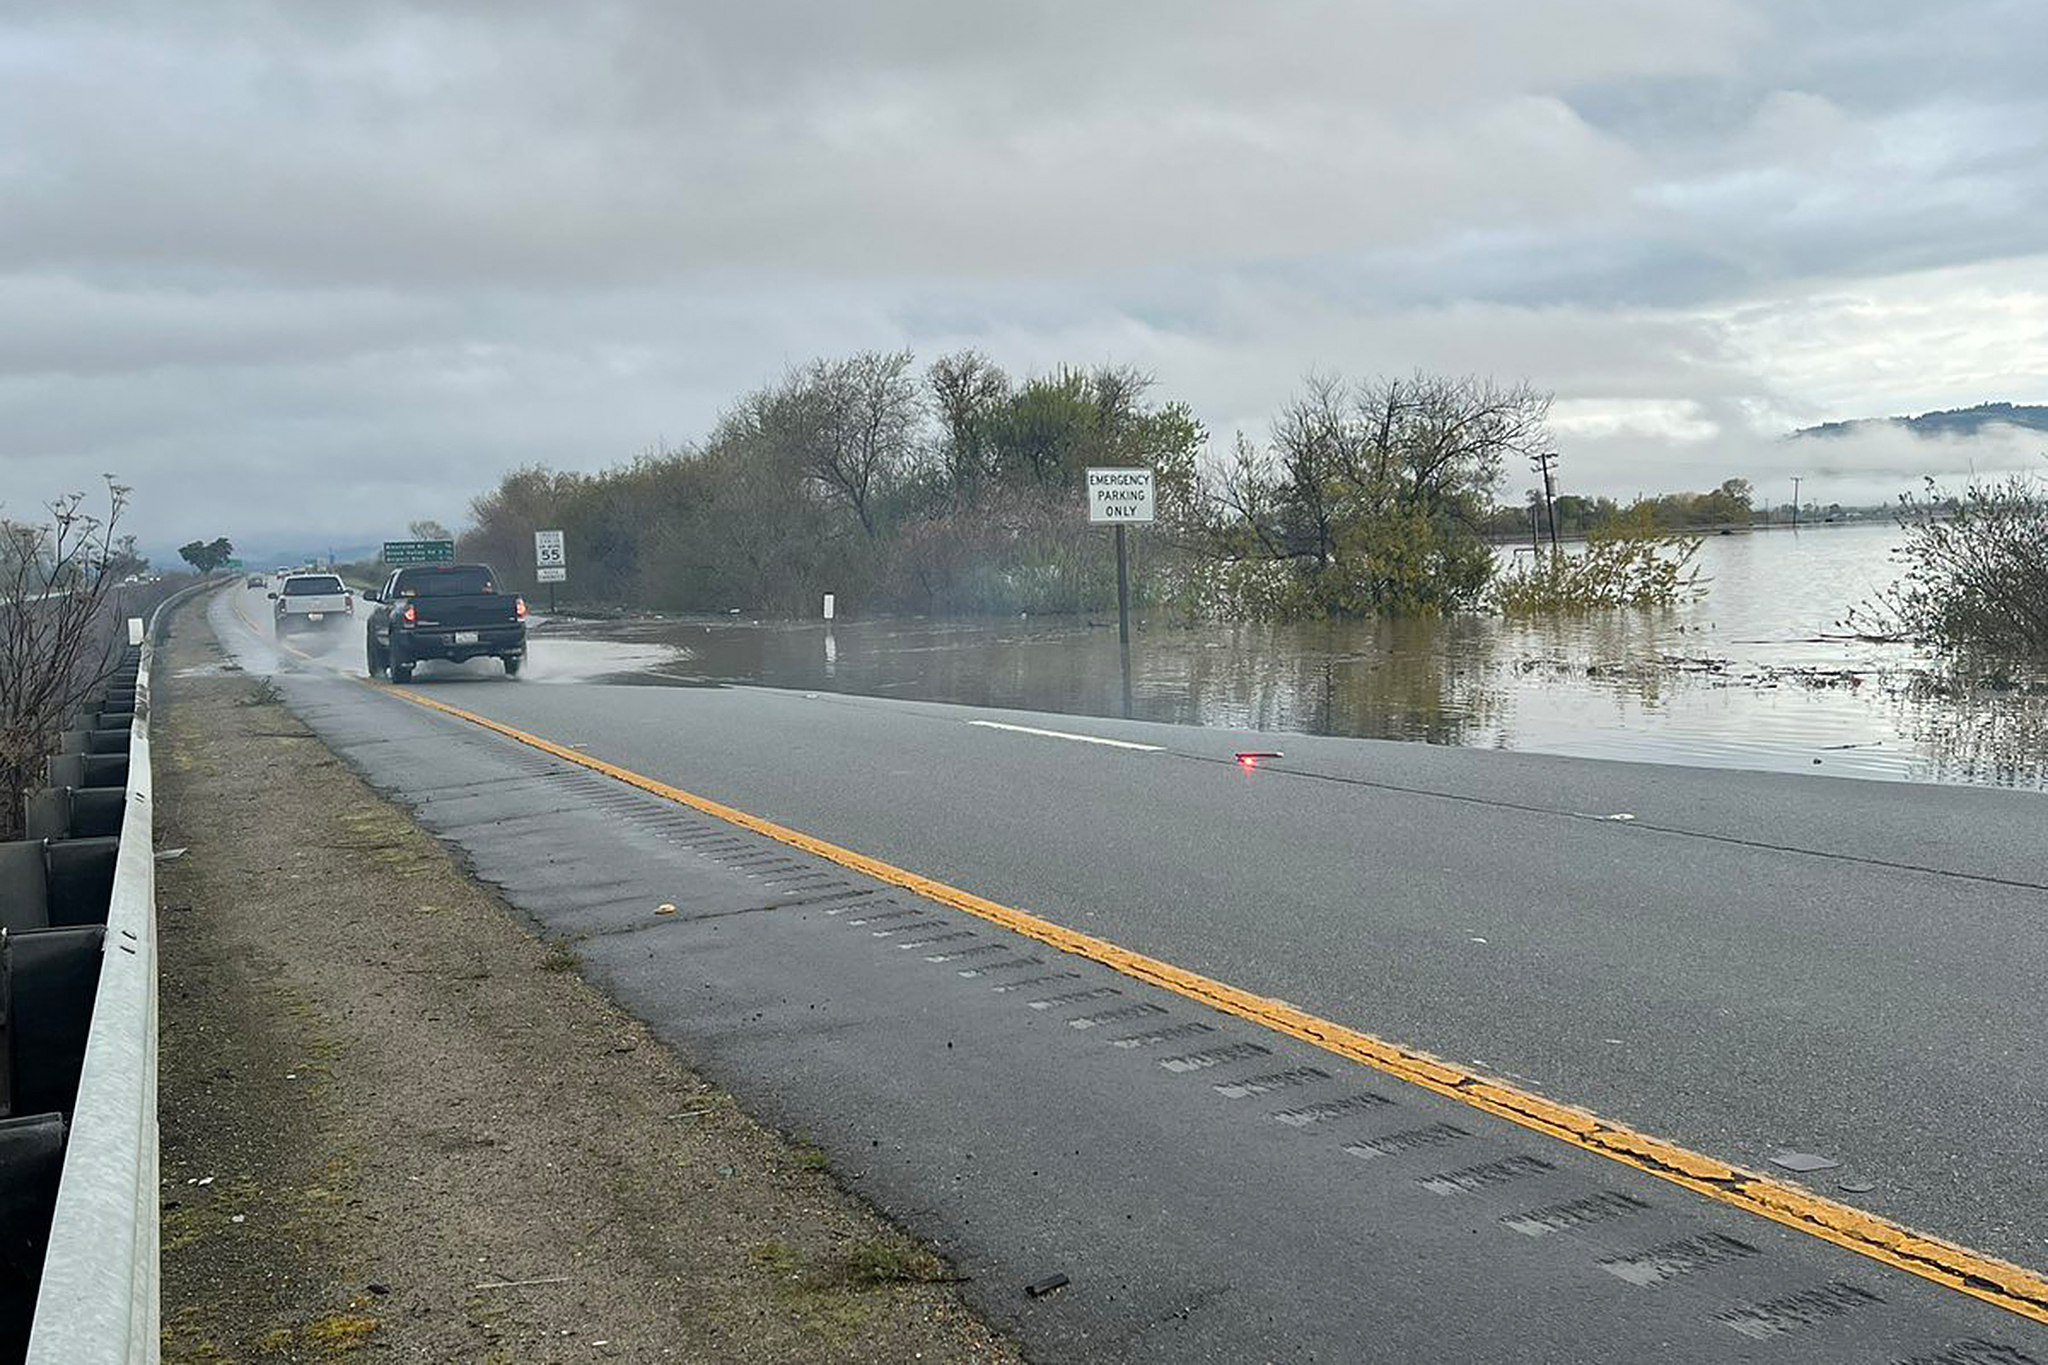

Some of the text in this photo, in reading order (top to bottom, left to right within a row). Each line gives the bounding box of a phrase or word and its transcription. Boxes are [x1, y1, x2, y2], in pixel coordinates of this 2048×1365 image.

[1090, 474, 1150, 485] EMERGENCY
[1098, 490, 1145, 501] PARKING
[1106, 505, 1137, 517] ONLY
[542, 549, 560, 561] 55
